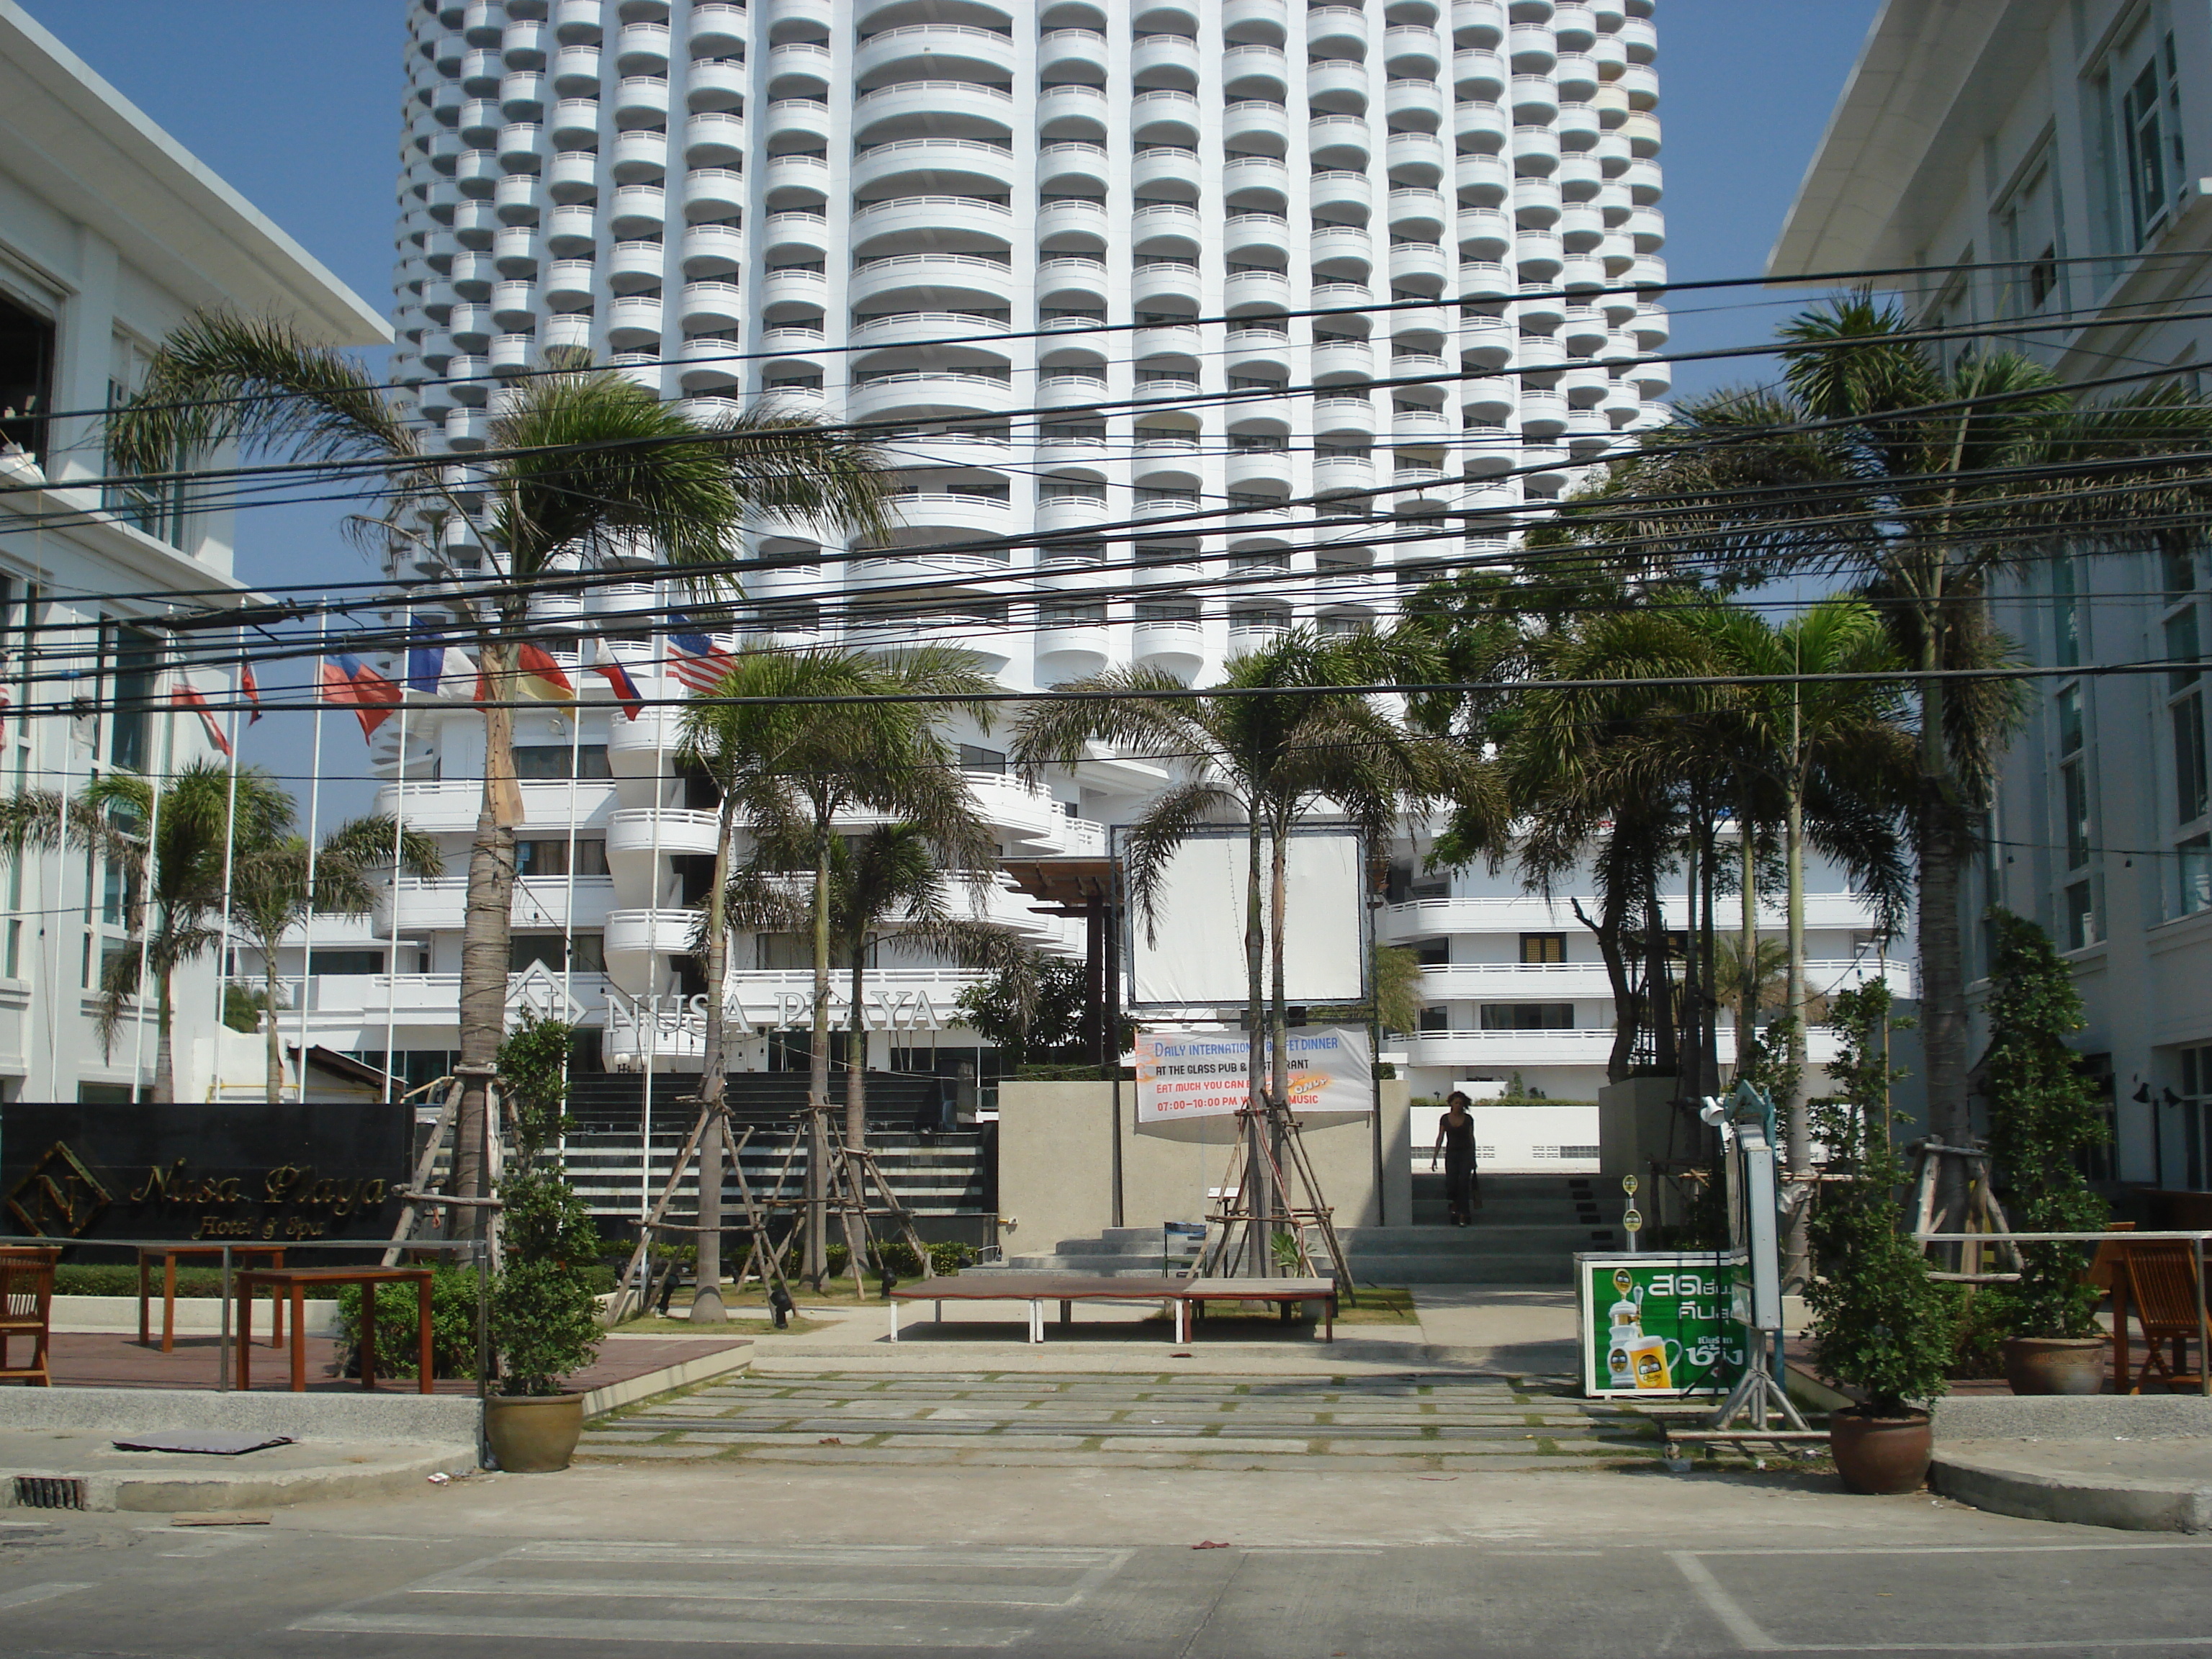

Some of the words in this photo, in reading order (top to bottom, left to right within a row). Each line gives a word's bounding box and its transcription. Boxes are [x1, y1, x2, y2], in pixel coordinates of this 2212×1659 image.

[604, 993, 754, 1033] NUSA
[1155, 1042, 1186, 1057] DAILY
[1190, 1042, 1251, 1056] INTERNATION
[1301, 1037, 1339, 1050] DINNER
[1156, 1066, 1166, 1076] AT
[1169, 1066, 1185, 1075] THE
[1187, 1064, 1216, 1074] GLASS
[1218, 1063, 1237, 1073] PUB
[1240, 1062, 1247, 1071] &
[1156, 1084, 1173, 1094] EAT
[1176, 1082, 1201, 1092] MUCH
[1204, 1081, 1222, 1090] YOU
[1224, 1080, 1244, 1089] CAN
[1294, 1078, 1328, 1094] ONLY
[1222, 1097, 1238, 1105] PM
[1288, 1094, 1319, 1105] MUSIC
[130, 1156, 243, 1203] Nusa
[264, 1162, 387, 1216] Playa
[192, 1215, 255, 1240] Hotel
[286, 1216, 324, 1241] Spa
